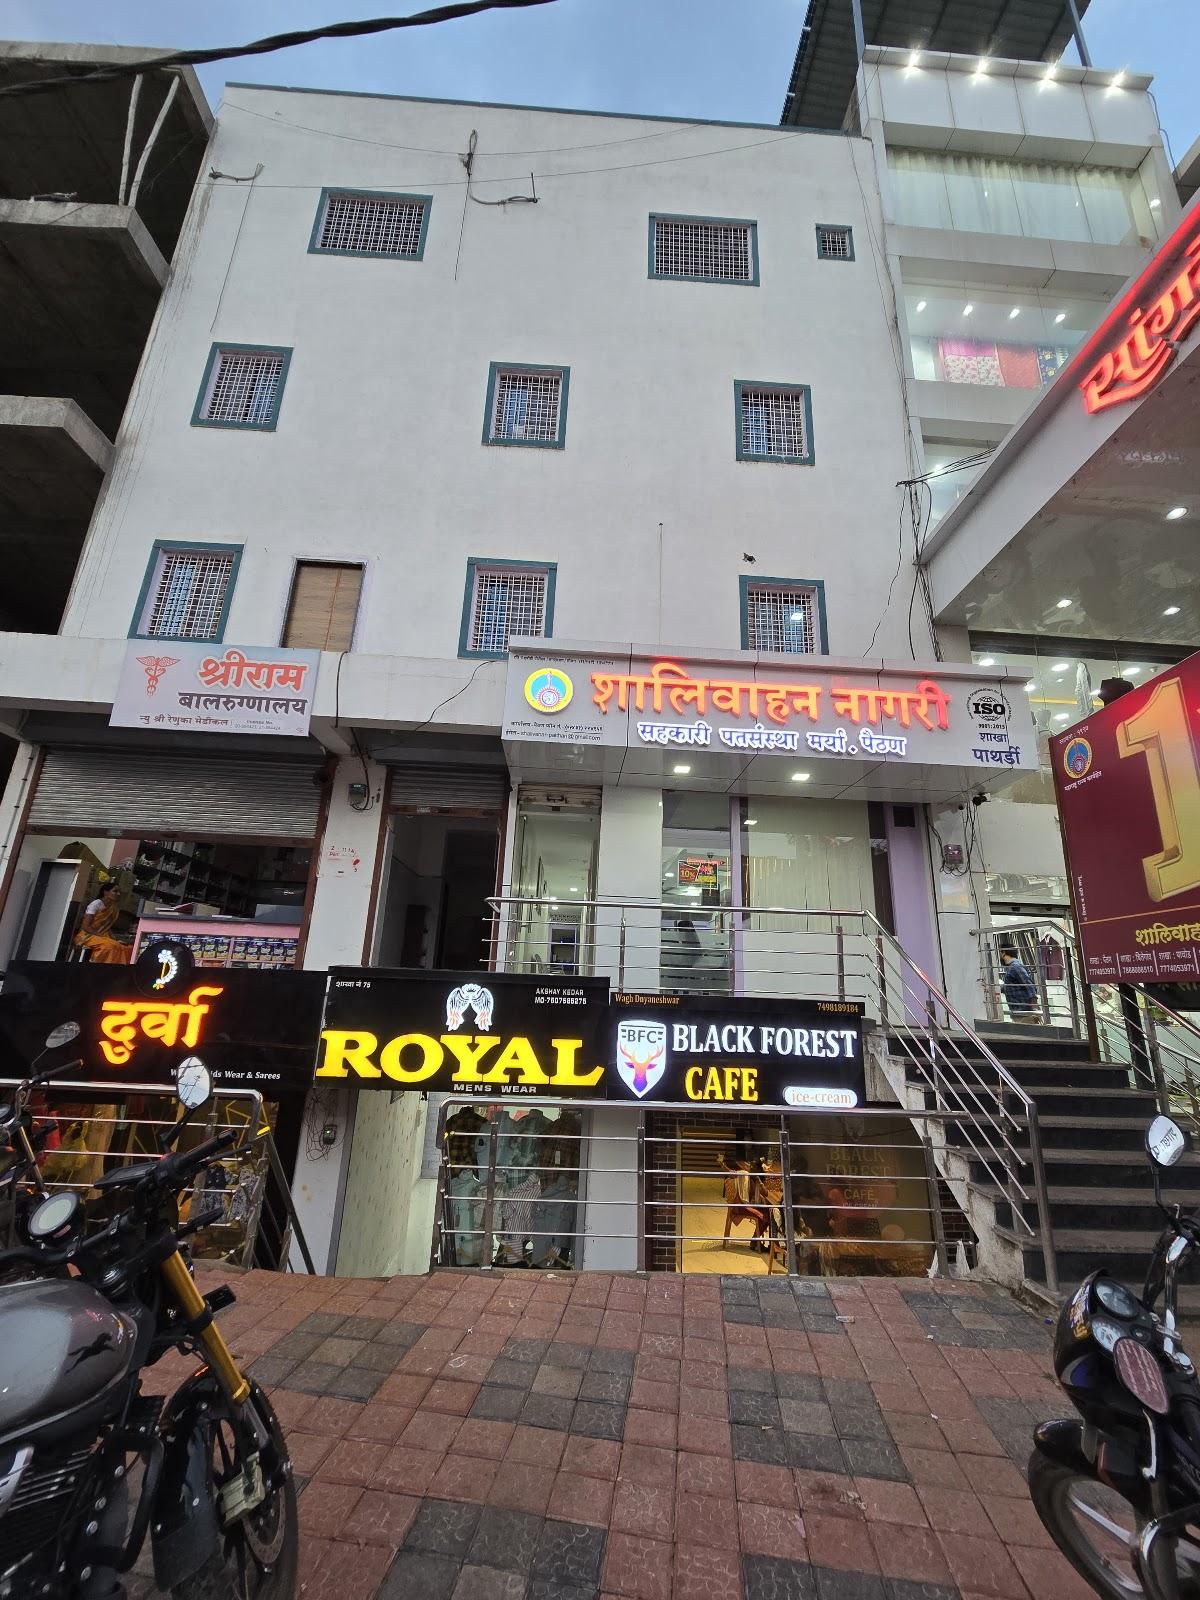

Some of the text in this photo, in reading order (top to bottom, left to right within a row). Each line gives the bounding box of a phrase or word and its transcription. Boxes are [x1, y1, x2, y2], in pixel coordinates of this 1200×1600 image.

[199, 650, 307, 691] श्रीराम
[178, 692, 308, 715] बालरुग्णालय
[590, 661, 822, 725] शालिवाहन
[830, 679, 952, 731] नागरी
[973, 702, 1006, 715] ISO
[637, 720, 712, 744] सहकारी
[719, 723, 799, 749] पतसंस्था
[859, 727, 907, 757] पैठण
[979, 732, 1007, 743] शाखा
[972, 746, 1021, 765] पाथर्डी
[615, 993, 680, 1005] Wagh Dnyaneshwar
[817, 1003, 859, 1013] 7498189184
[98, 986, 223, 1064] दुर्वा
[628, 1029, 658, 1044] BFC
[672, 1023, 857, 1058] BLACK FOREST
[316, 1030, 605, 1086] ROYAL
[224, 1070, 244, 1078] Wear
[685, 1066, 759, 1101] CAFE
[453, 1083, 537, 1093] MENS WEAR
[792, 1089, 852, 1105] ice-cream
